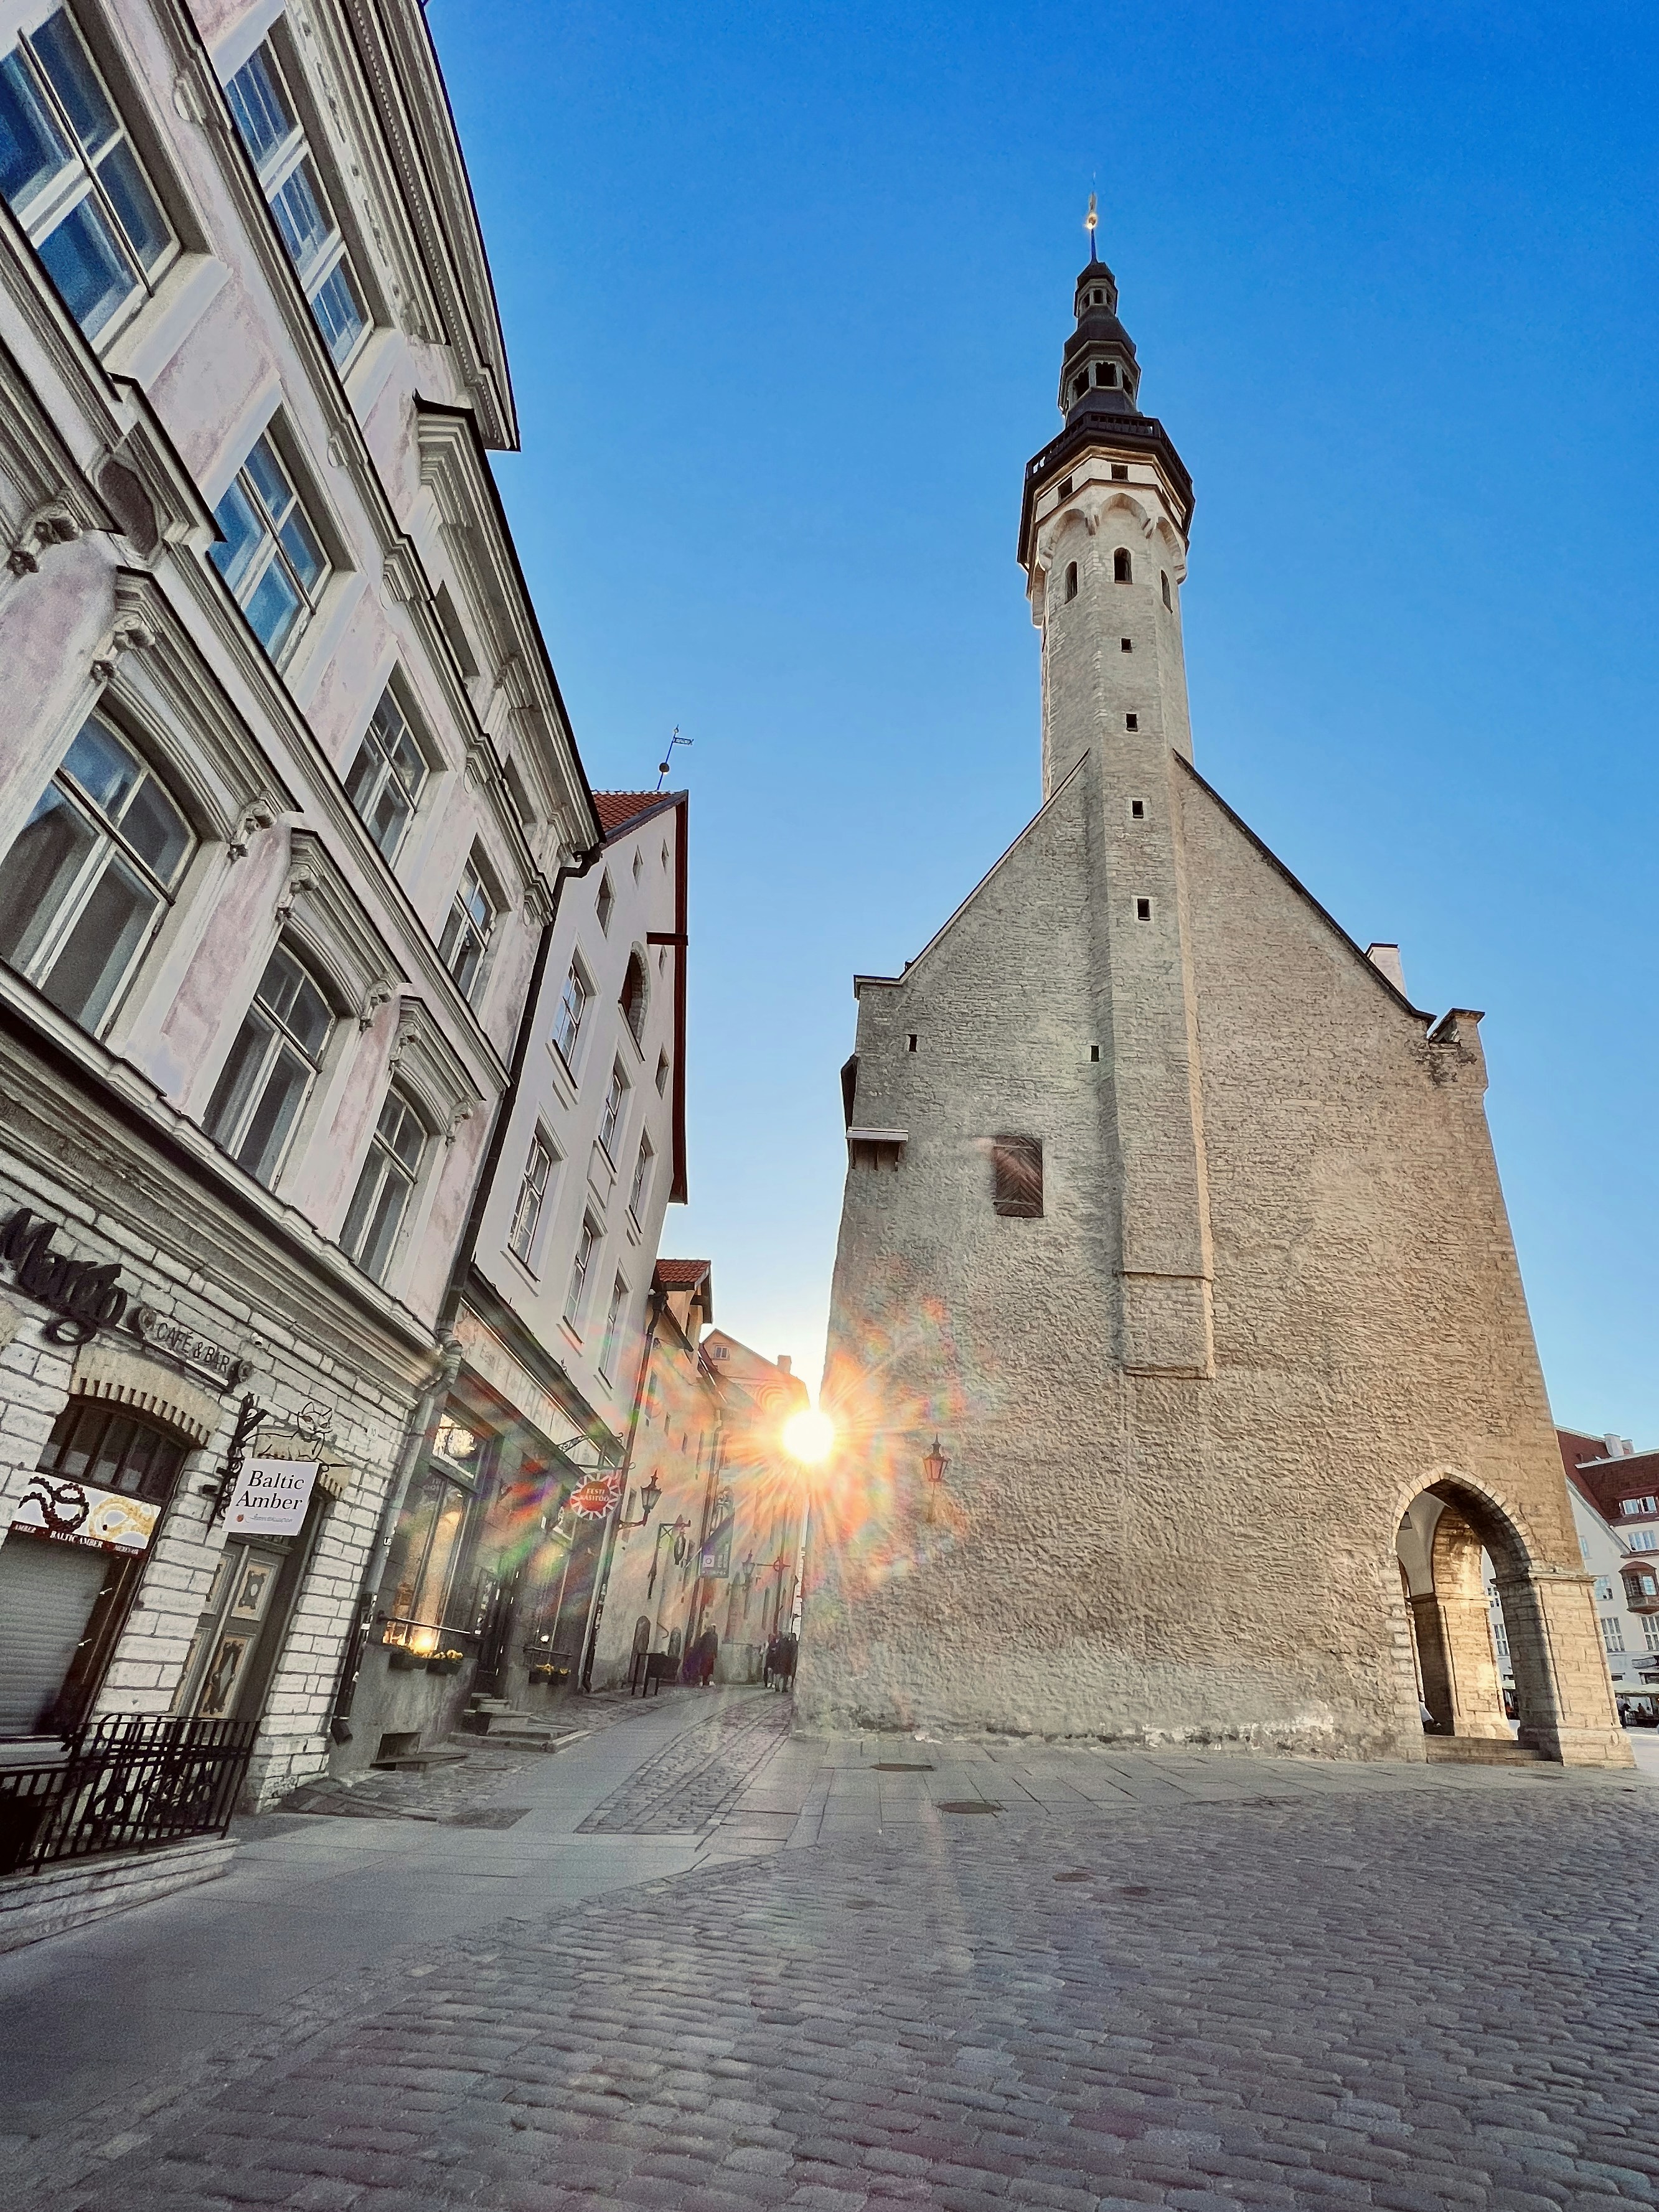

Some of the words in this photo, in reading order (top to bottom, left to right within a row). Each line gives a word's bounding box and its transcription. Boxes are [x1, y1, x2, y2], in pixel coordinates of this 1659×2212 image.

[157, 1322, 194, 1354] CAFÉ
[193, 1341, 204, 1359] &
[204, 1346, 230, 1374] BAR
[247, 1469, 304, 1490] Baltic
[235, 1490, 303, 1510] Amber
[49, 1530, 78, 1543] BALTIC
[78, 1537, 103, 1549] AMBER
